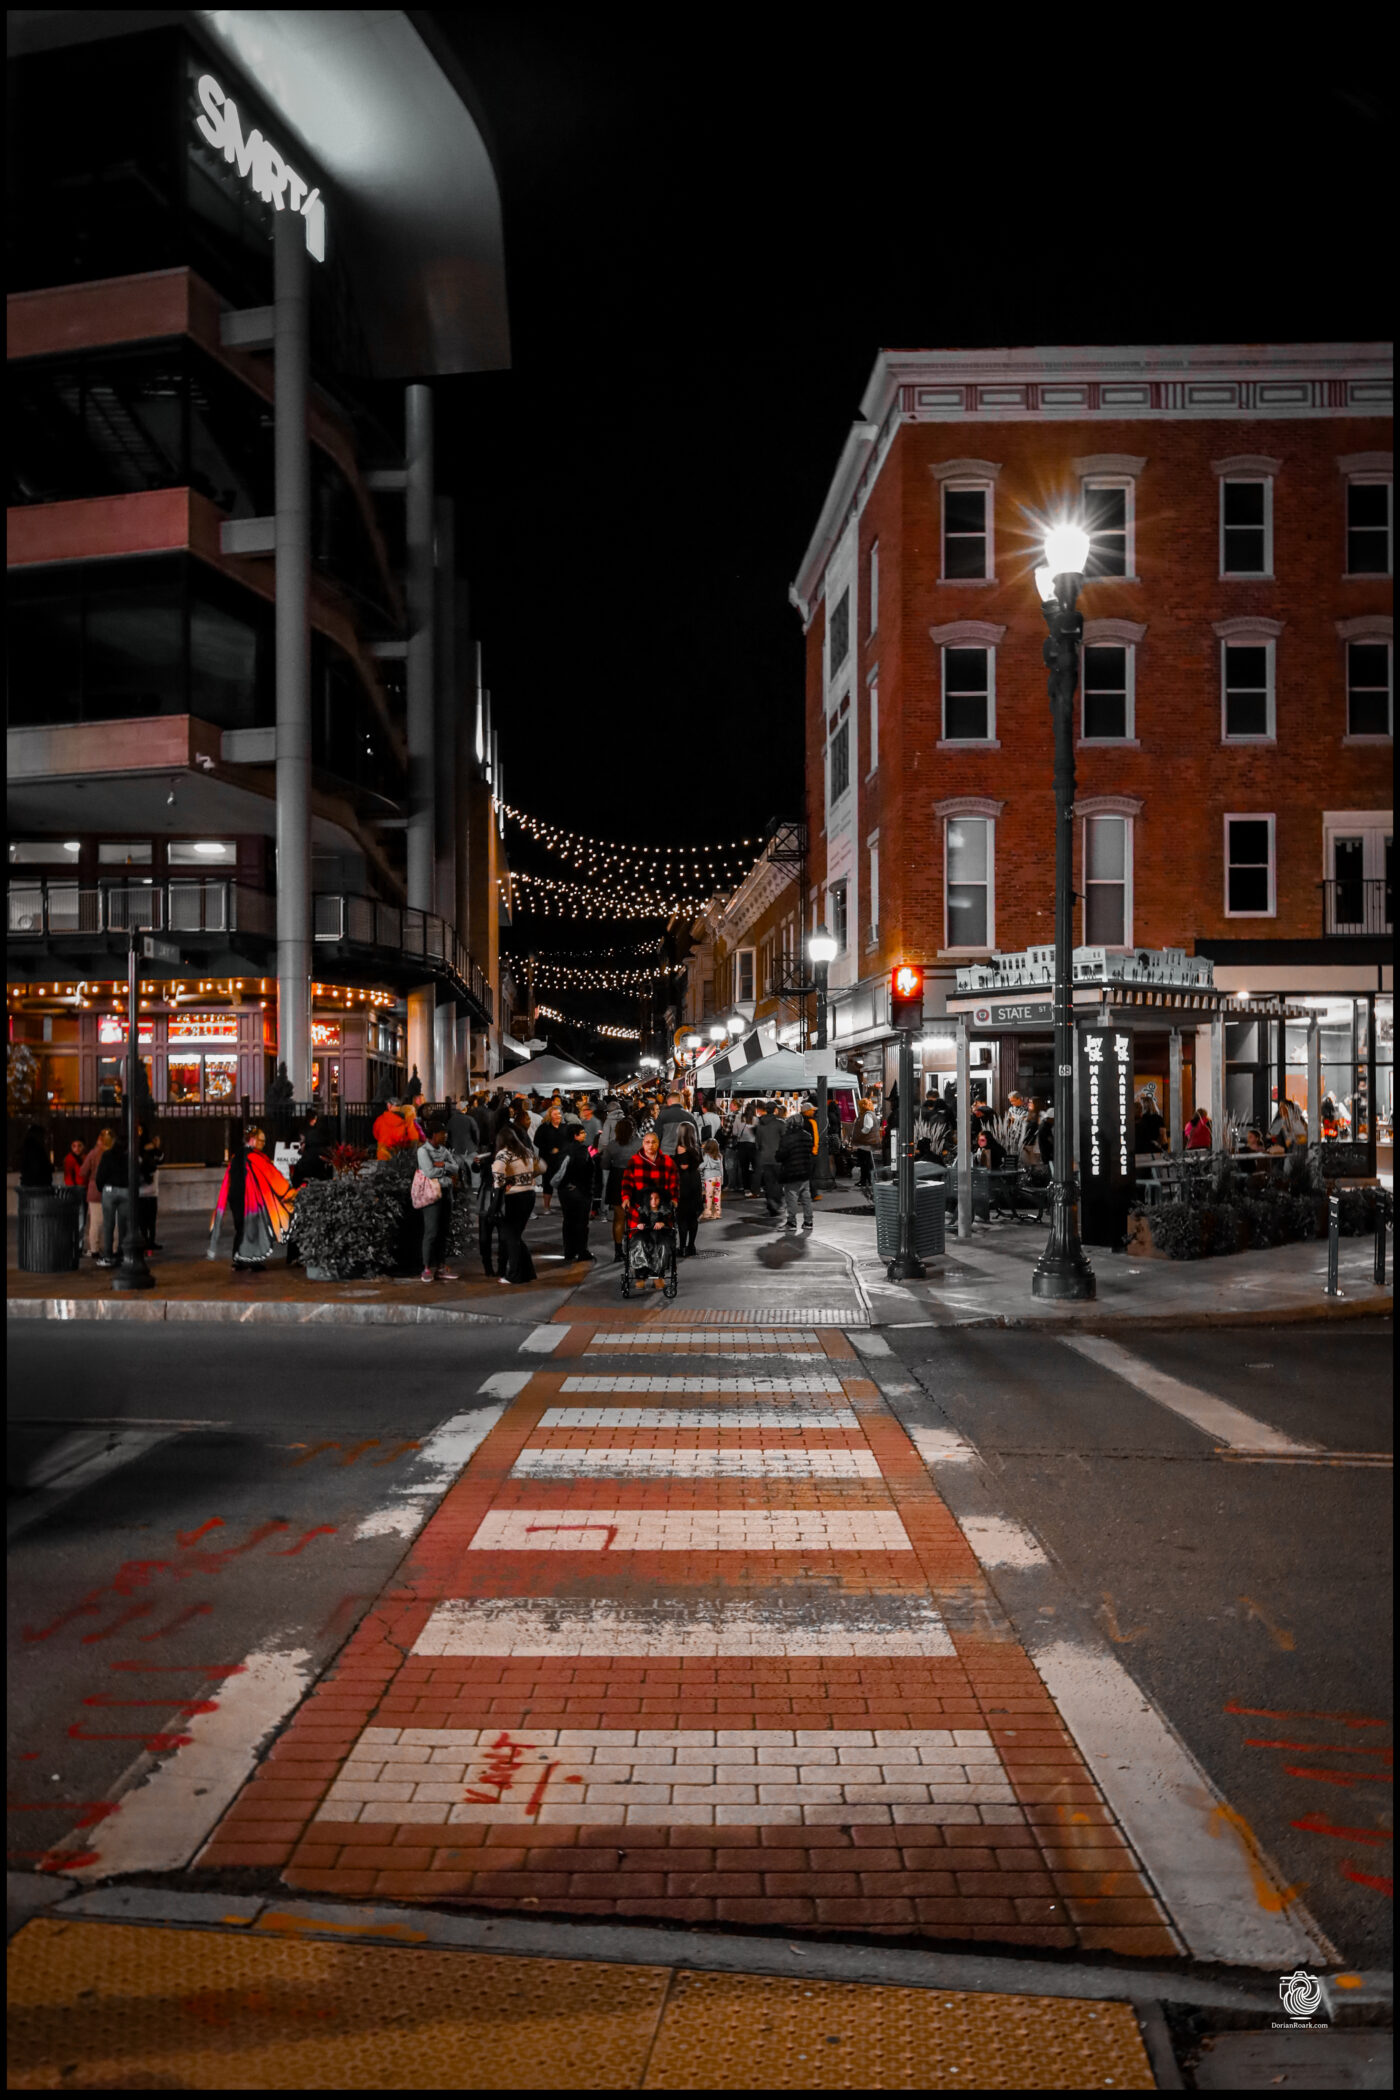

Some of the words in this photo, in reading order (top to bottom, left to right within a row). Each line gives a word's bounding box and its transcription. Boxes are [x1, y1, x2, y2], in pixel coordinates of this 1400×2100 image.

[998, 1006, 1032, 1020] STATE
[1060, 1065, 1070, 1075] 68
[1089, 1064, 1100, 1176] MARKETPLACE
[1118, 1064, 1128, 1176] MARKETPLACE
